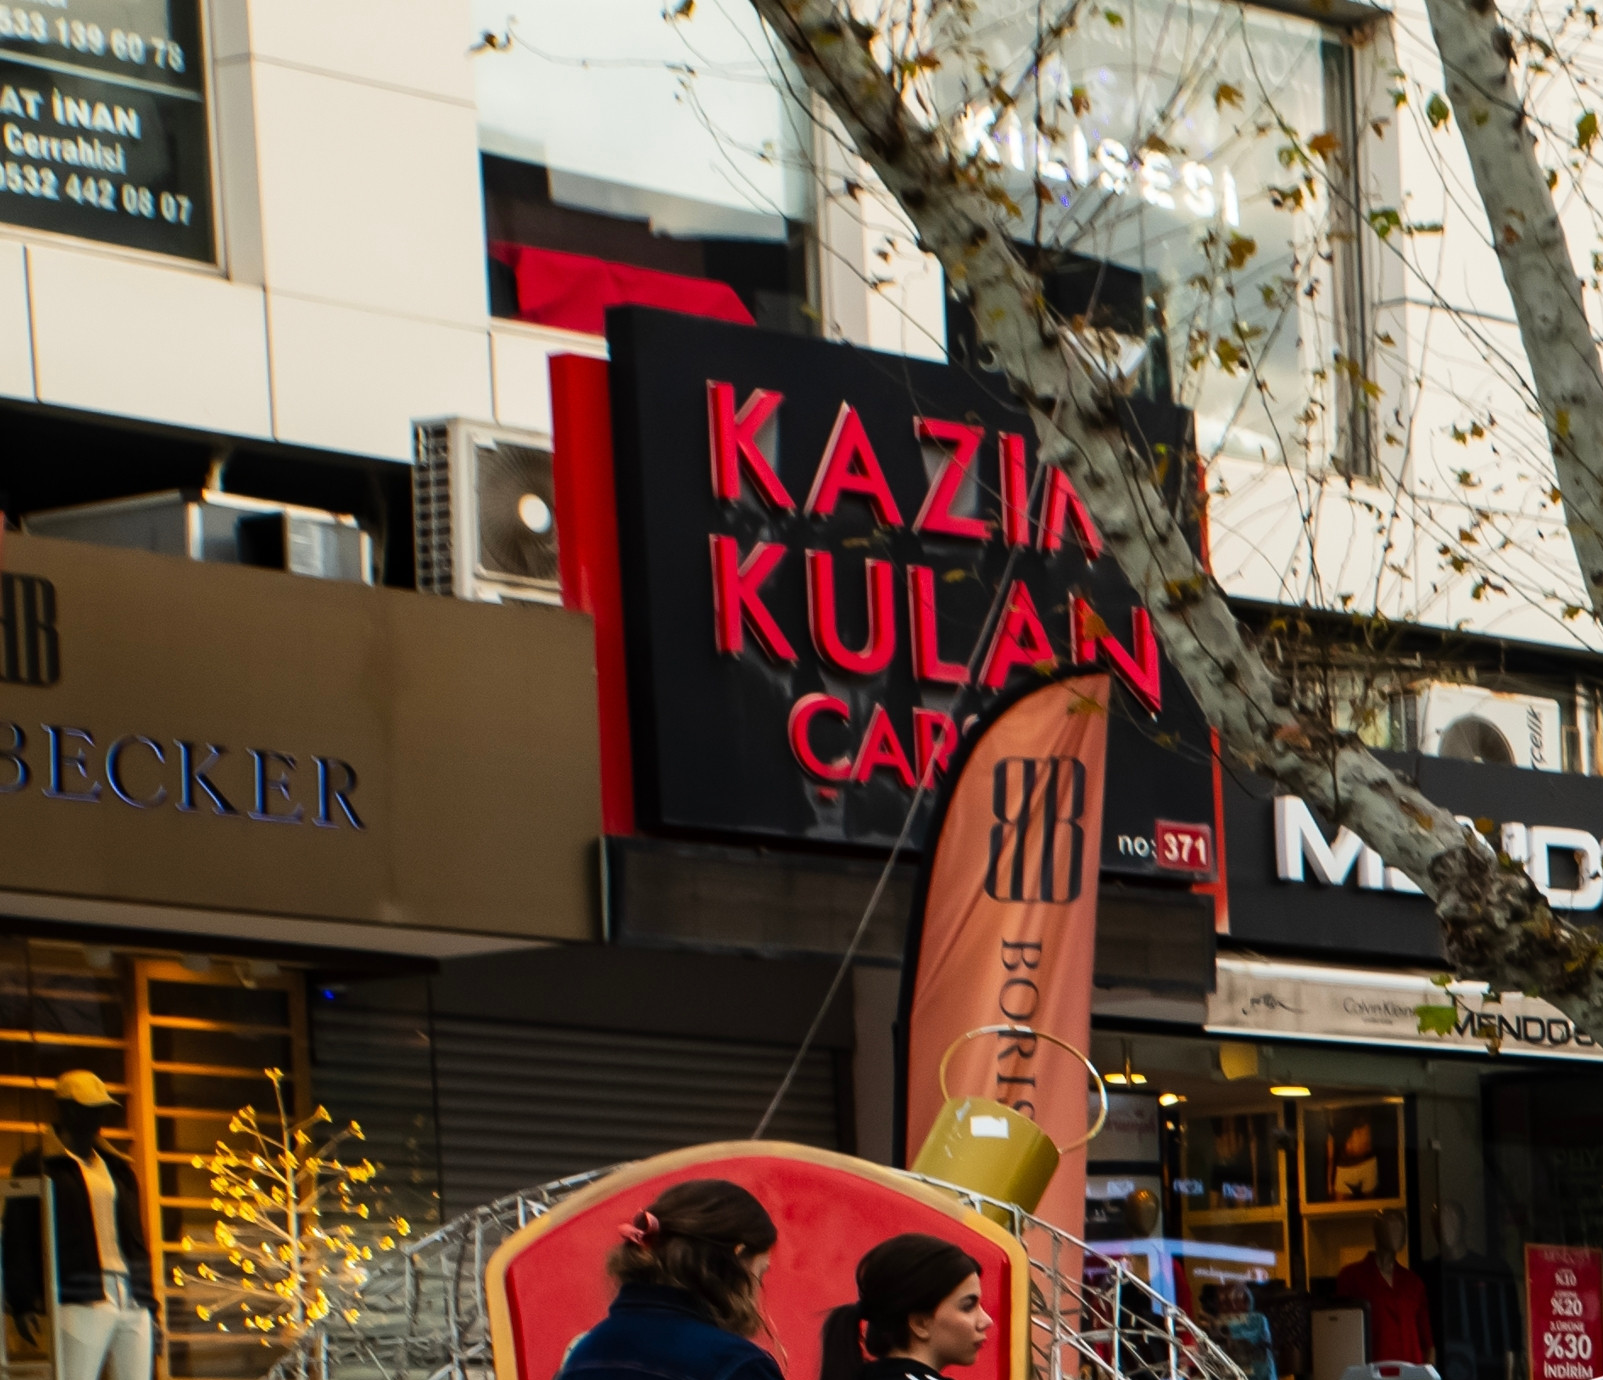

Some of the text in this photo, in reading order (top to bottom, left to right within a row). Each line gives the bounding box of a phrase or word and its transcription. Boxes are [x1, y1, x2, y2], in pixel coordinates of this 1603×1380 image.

[52, 87, 141, 140] İNAN
[65, 173, 117, 211] 442
[159, 190, 193, 226] 07
[709, 533, 1162, 721] KULAN
[0, 721, 365, 831] BECKER
[1162, 833, 1208, 865] 371
[1550, 1298, 1583, 1317] %20
[1543, 1333, 1592, 1359] %30
[1543, 1361, 1593, 1380] İNDİRİM
